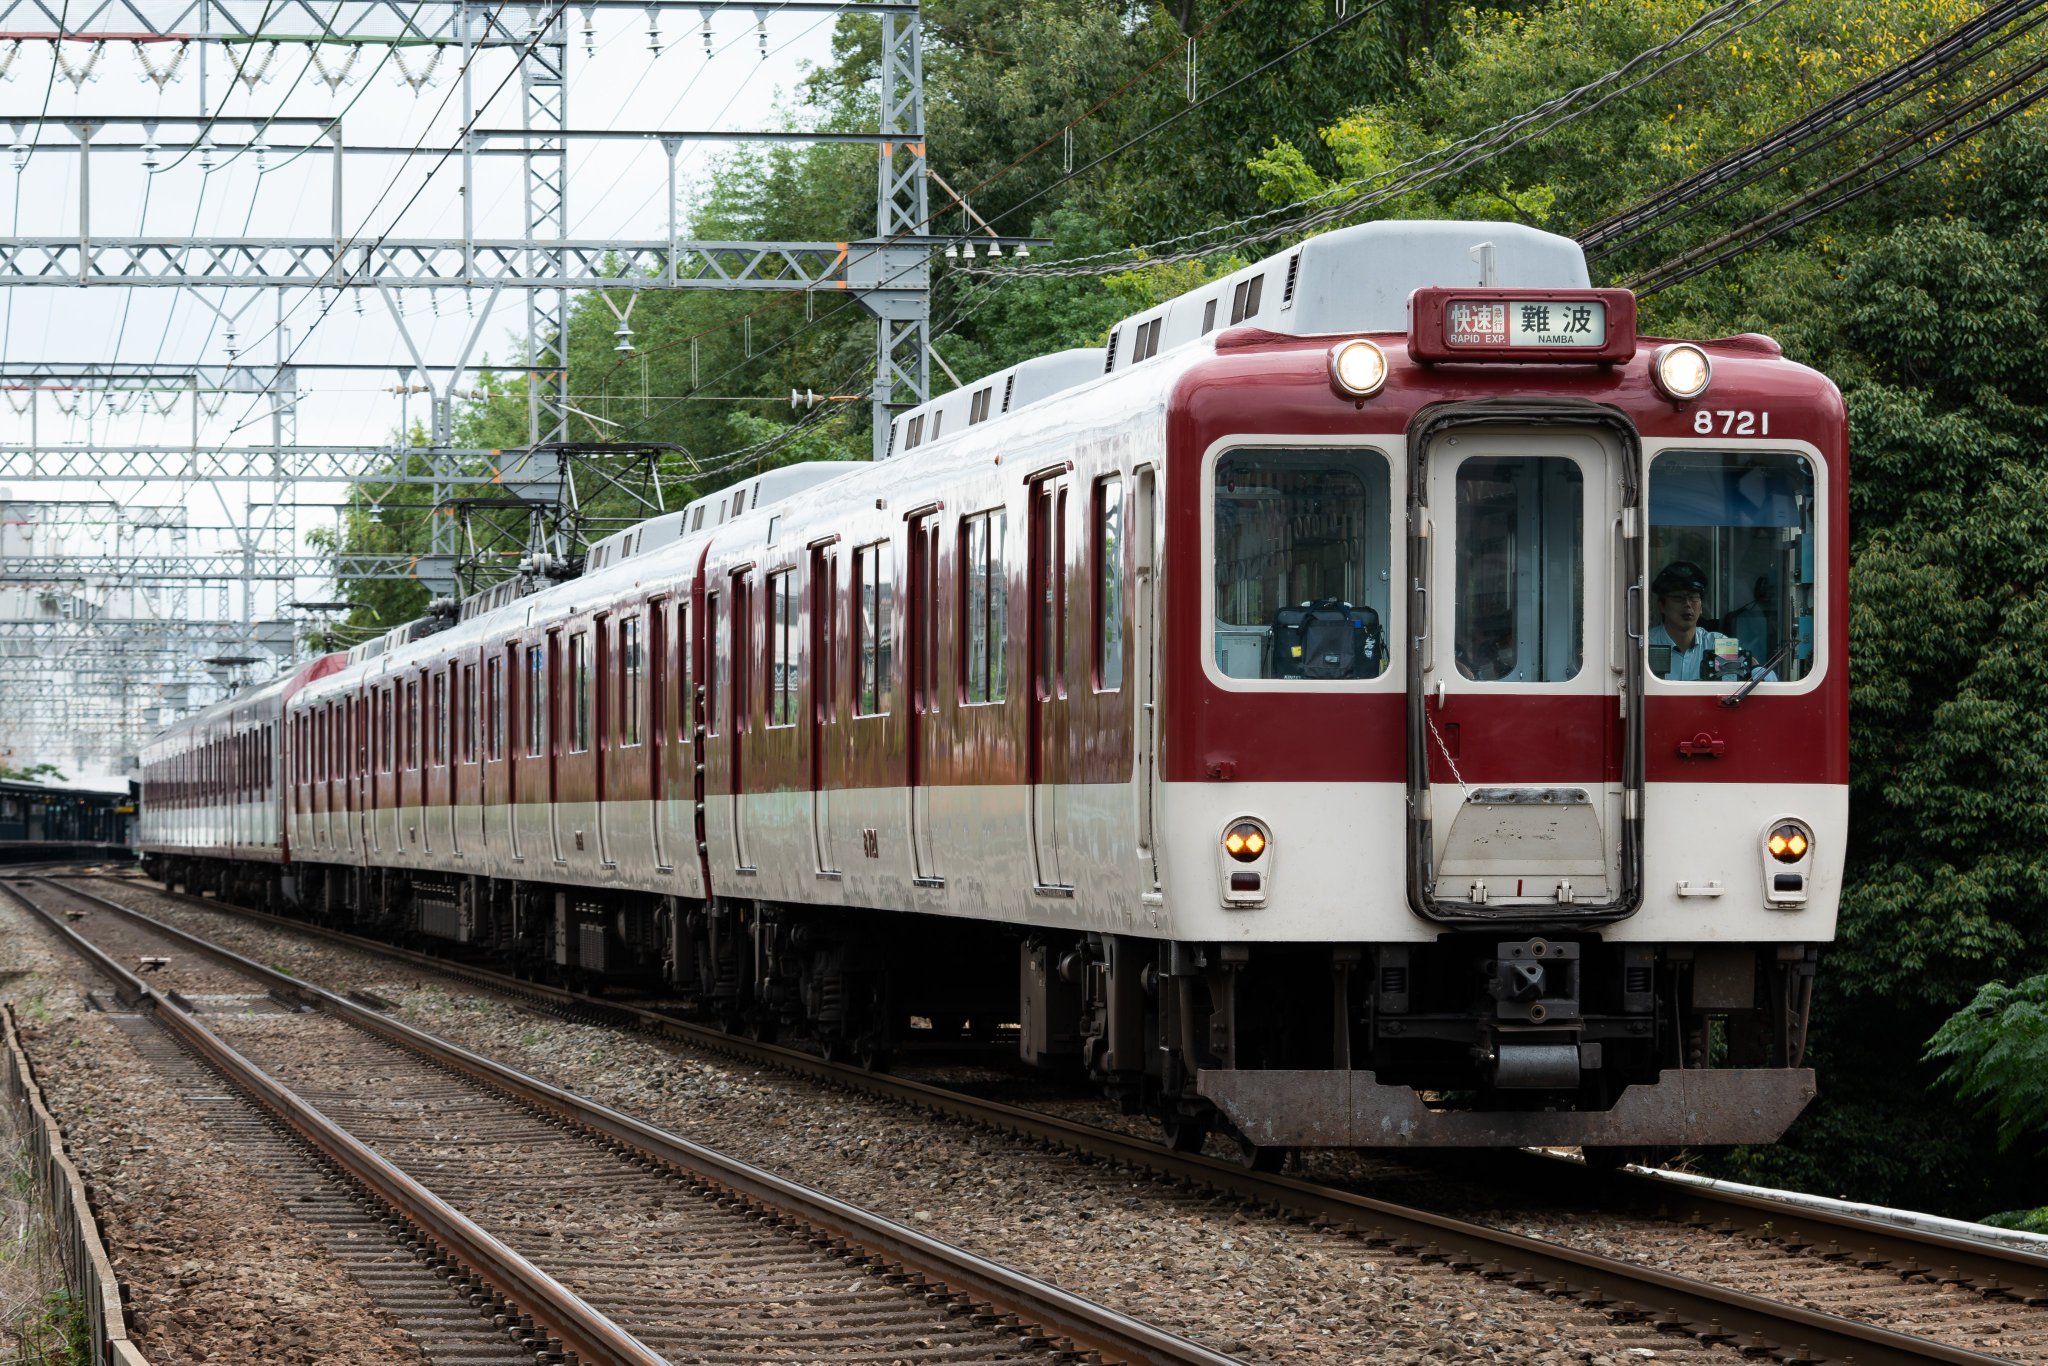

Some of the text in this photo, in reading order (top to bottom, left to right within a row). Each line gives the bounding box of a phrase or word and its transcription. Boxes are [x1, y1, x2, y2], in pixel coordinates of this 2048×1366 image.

[1521, 305, 1592, 334] 難波
[1450, 334, 1506, 343] RAPID EXP.
[1538, 335, 1575, 344] NAMBA
[1693, 410, 1768, 435] 8721
